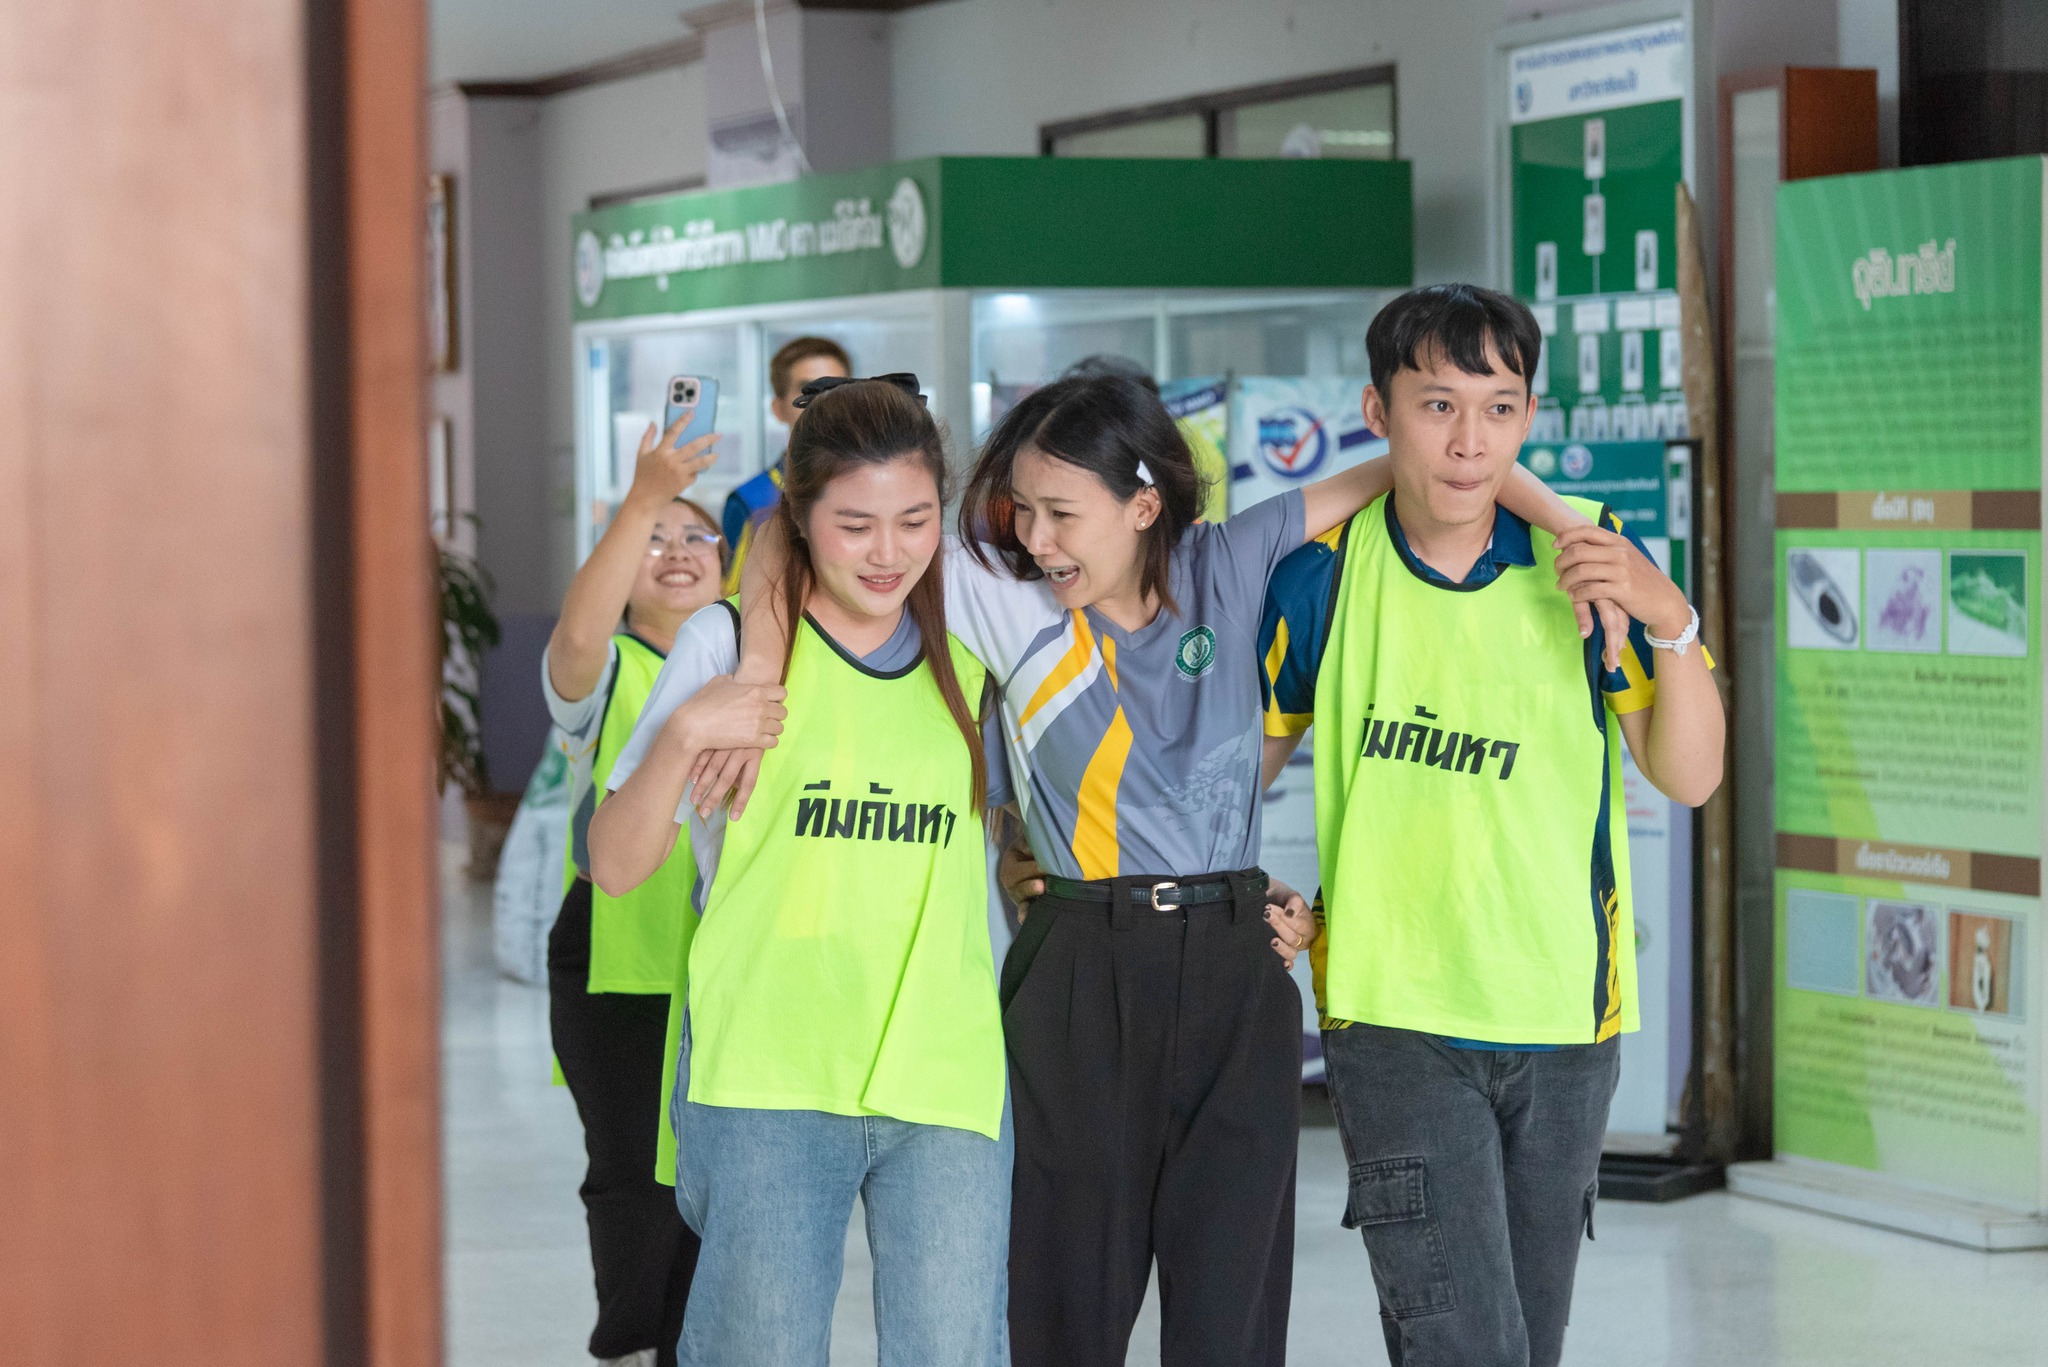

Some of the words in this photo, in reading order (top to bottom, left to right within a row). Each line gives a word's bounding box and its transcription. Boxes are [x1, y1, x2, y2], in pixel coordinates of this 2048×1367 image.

[1852, 237, 1957, 312] จุลินทรีย์
[1361, 703, 1521, 781] มค้นหา
[795, 780, 957, 850] ทีมค้นหา
